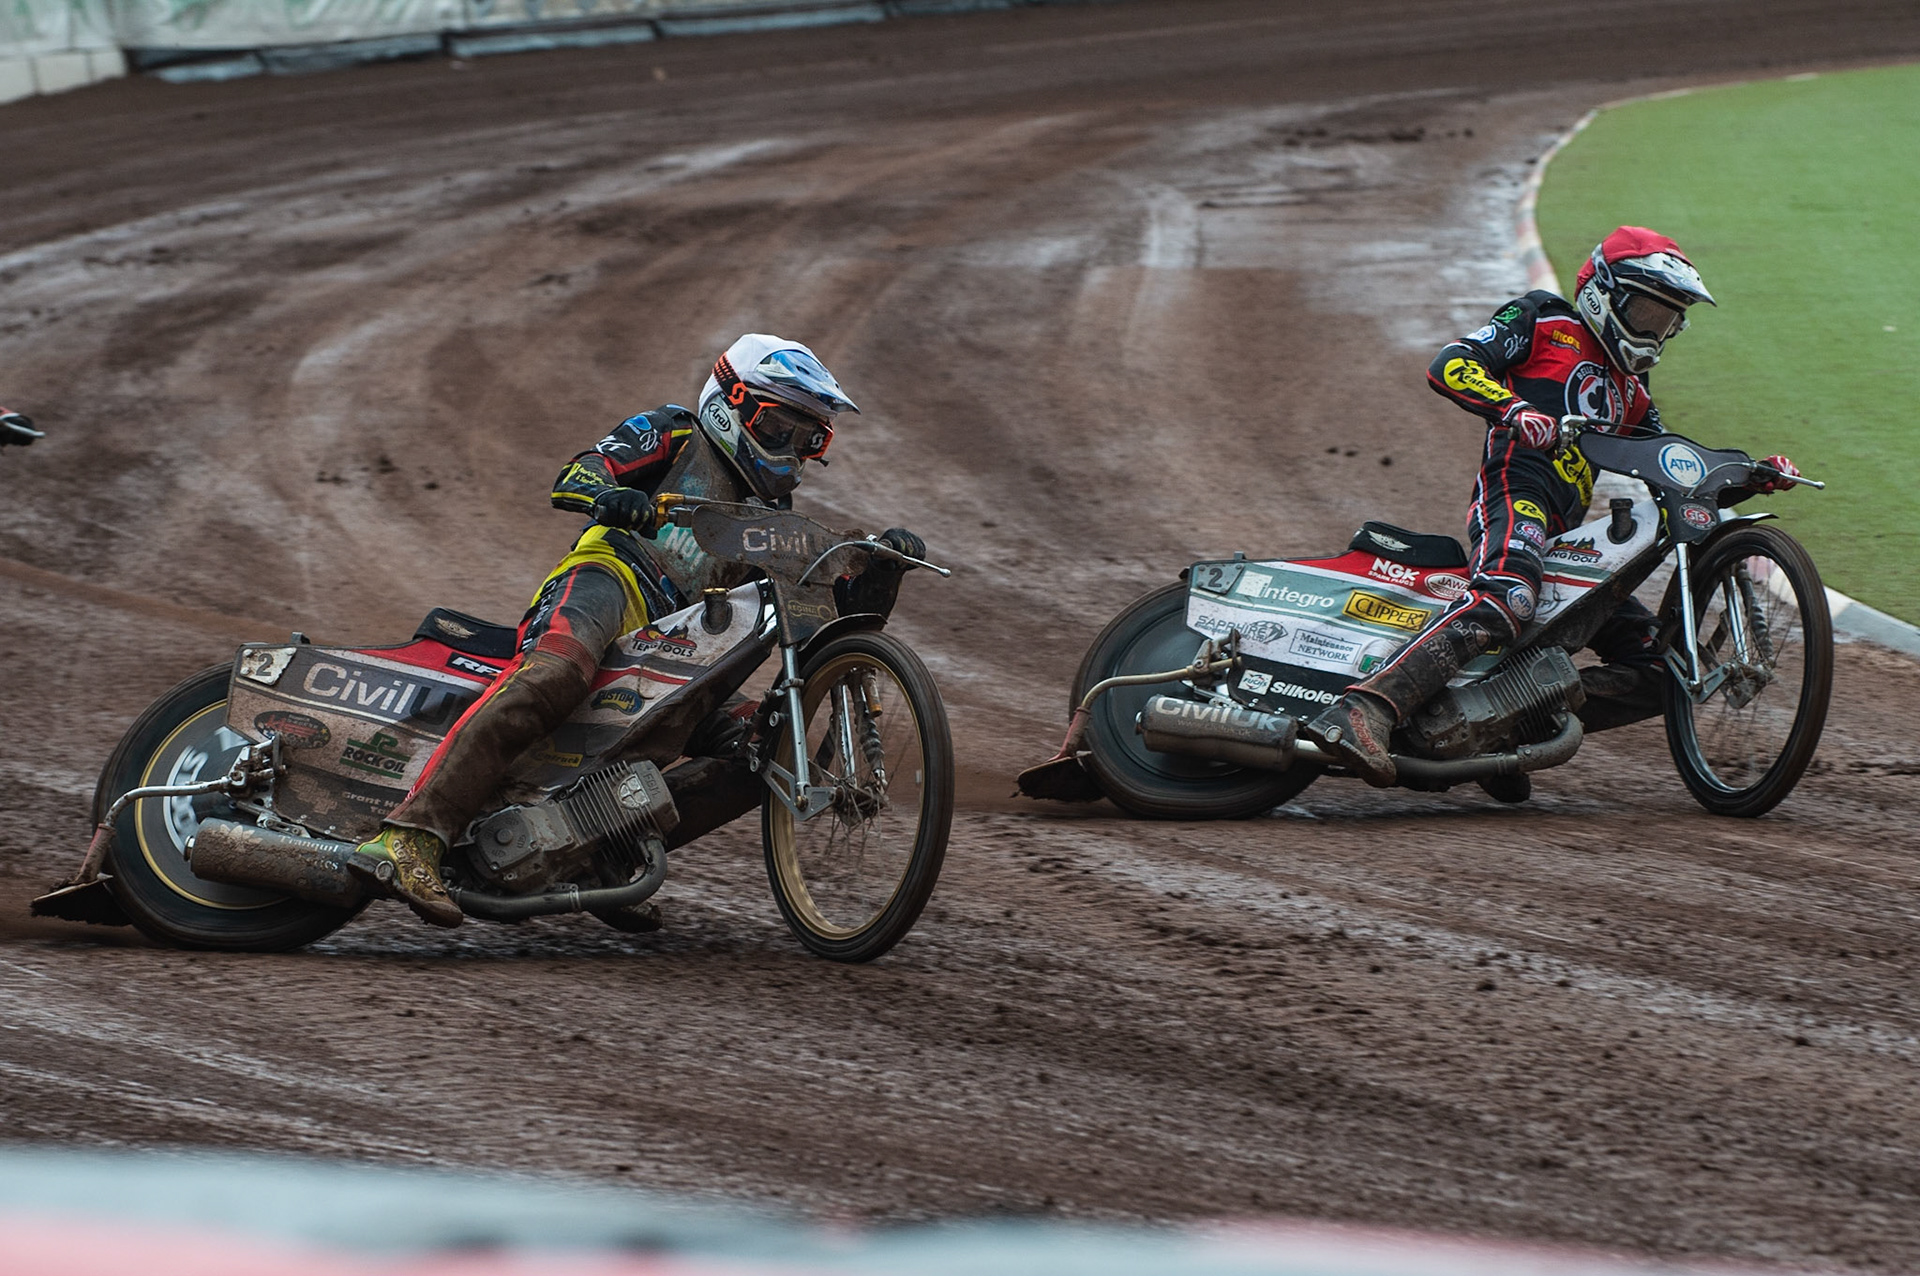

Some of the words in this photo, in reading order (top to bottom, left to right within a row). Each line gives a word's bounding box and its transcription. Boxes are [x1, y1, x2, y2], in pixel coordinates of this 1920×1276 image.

[1576, 366, 1594, 380] BELLE
[1669, 458, 1697, 472] ATPI
[1208, 568, 1223, 588] 2
[1368, 571, 1390, 582] SPARK
[1390, 578, 1415, 587] PLUGS
[1371, 557, 1420, 581] NGK
[1437, 577, 1469, 590] JAWA
[1260, 582, 1335, 608] integro
[1355, 598, 1419, 625] CLIPPER
[1198, 615, 1269, 637] SAPPHIRE
[1300, 632, 1354, 652] Maintenance
[1297, 643, 1350, 662] NETWORK
[256, 653, 273, 677] 2
[1242, 677, 1268, 687] FUCHS
[304, 662, 466, 726] CivilU
[1155, 696, 1278, 731] CivilUK
[342, 747, 380, 767] ROCK
[383, 758, 406, 773] OIL
[342, 791, 381, 806] Grant
